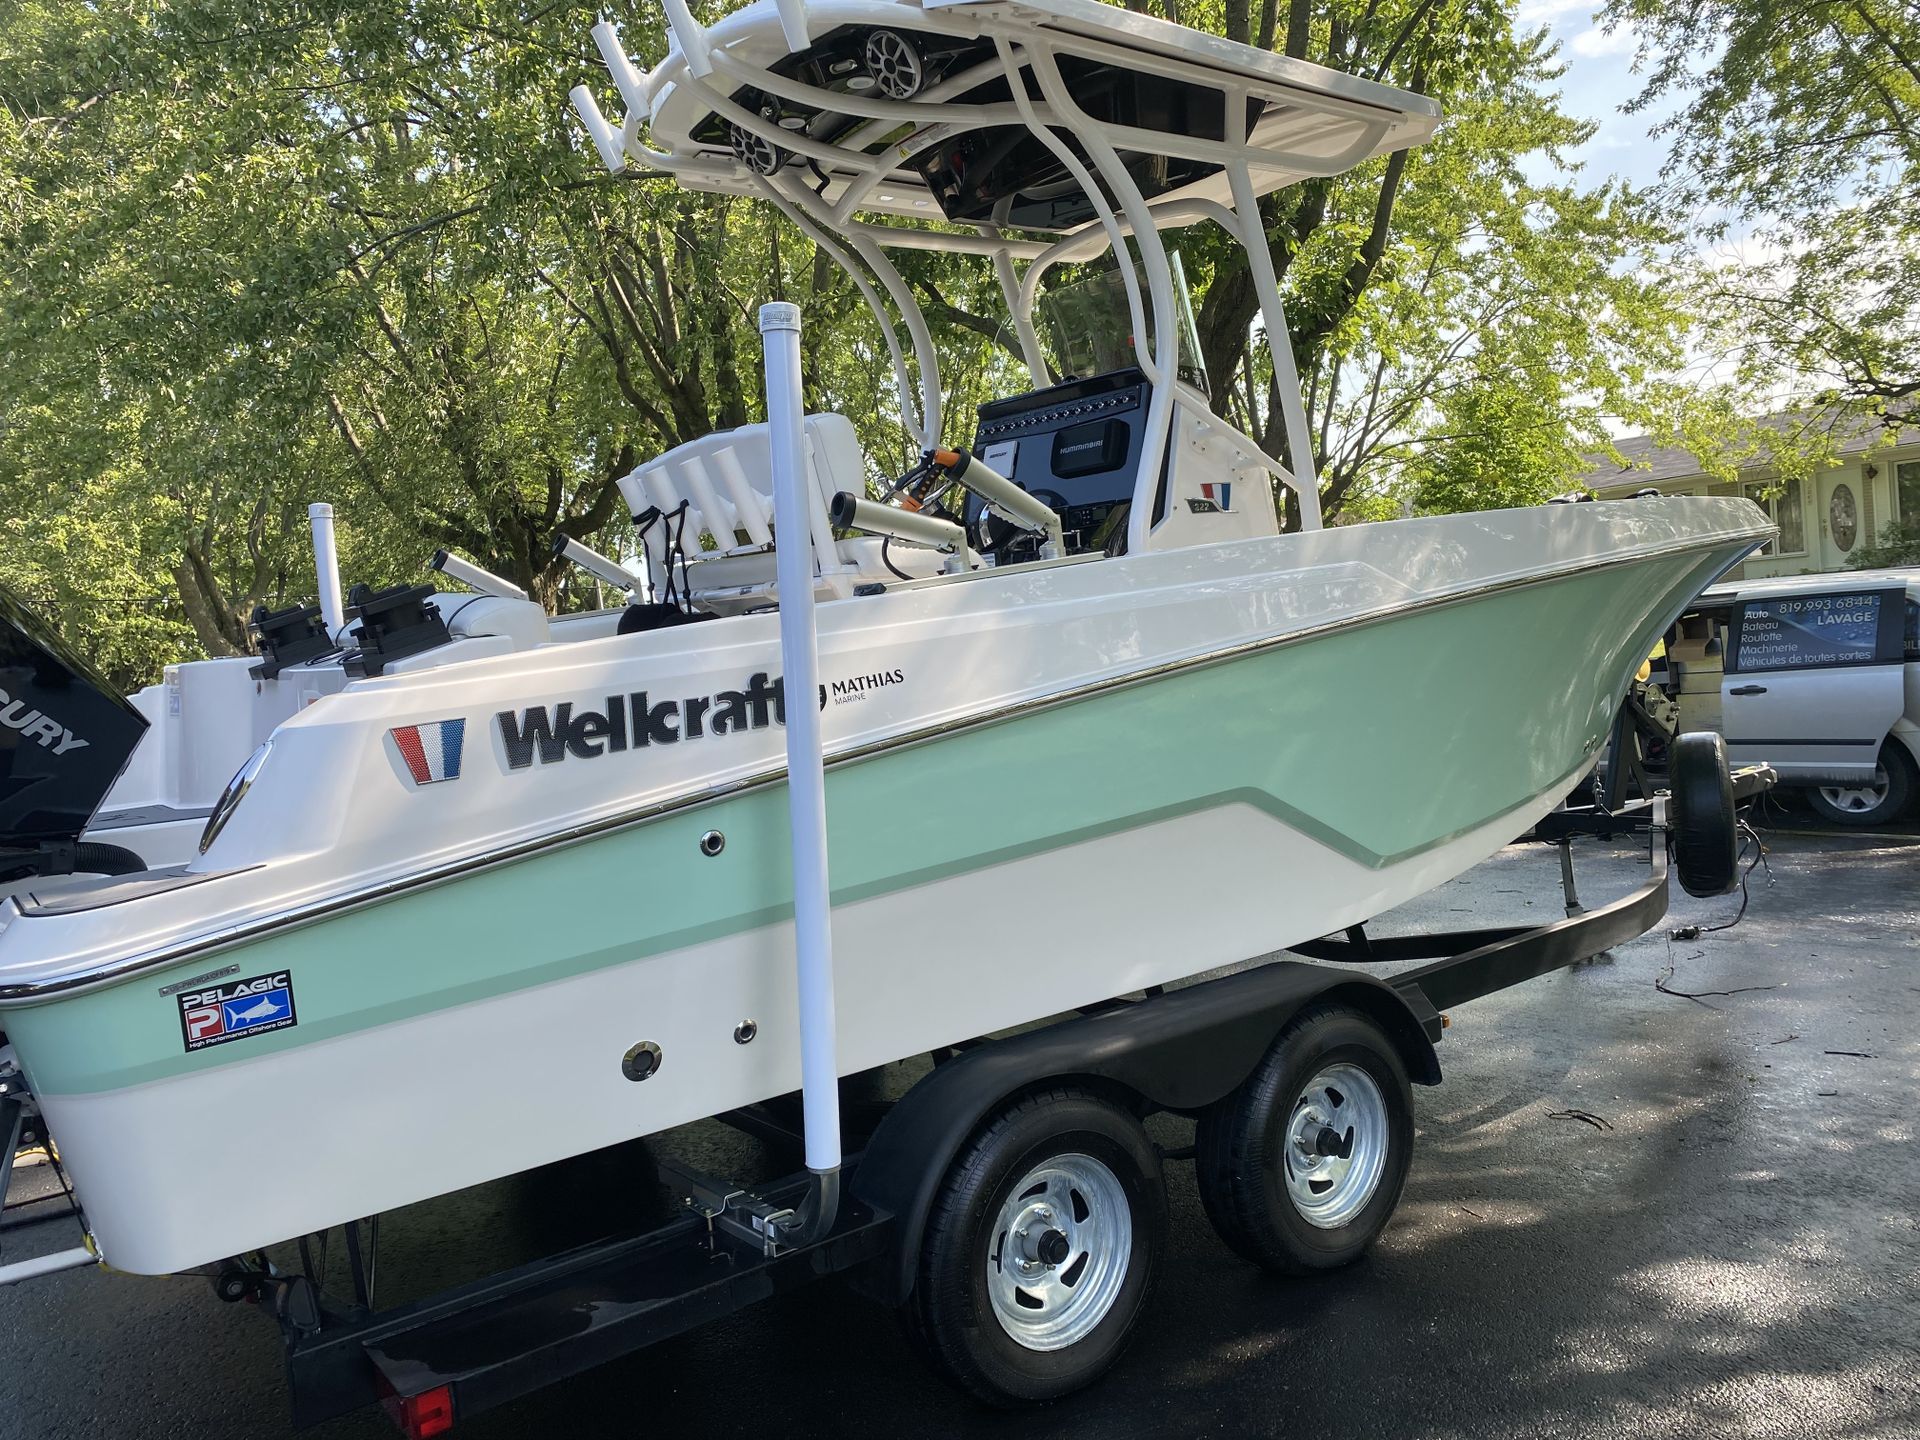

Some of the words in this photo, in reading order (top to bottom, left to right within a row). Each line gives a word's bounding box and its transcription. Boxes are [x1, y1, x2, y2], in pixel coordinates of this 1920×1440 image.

[1744, 610, 1769, 619] Auto
[1817, 611, 1872, 625] LAVAGE
[1742, 621, 1779, 631] Bateau
[1741, 632, 1783, 643] Roulotte
[1740, 643, 1798, 654] Machinerie
[1740, 655, 1786, 666] Véhicules
[1788, 653, 1803, 663] de
[1804, 652, 1836, 663] toutes
[1839, 651, 1871, 660] sortes
[832, 669, 904, 696] MATHIAS
[835, 692, 866, 705] MARINE
[497, 672, 786, 770] Wellcraft
[182, 973, 288, 1010] PELAGIC
[188, 1008, 220, 1039] P
[189, 1040, 206, 1049] High
[205, 1029, 248, 1045] Performance
[248, 1023, 277, 1034] Offshore
[277, 1019, 293, 1027] Gear
